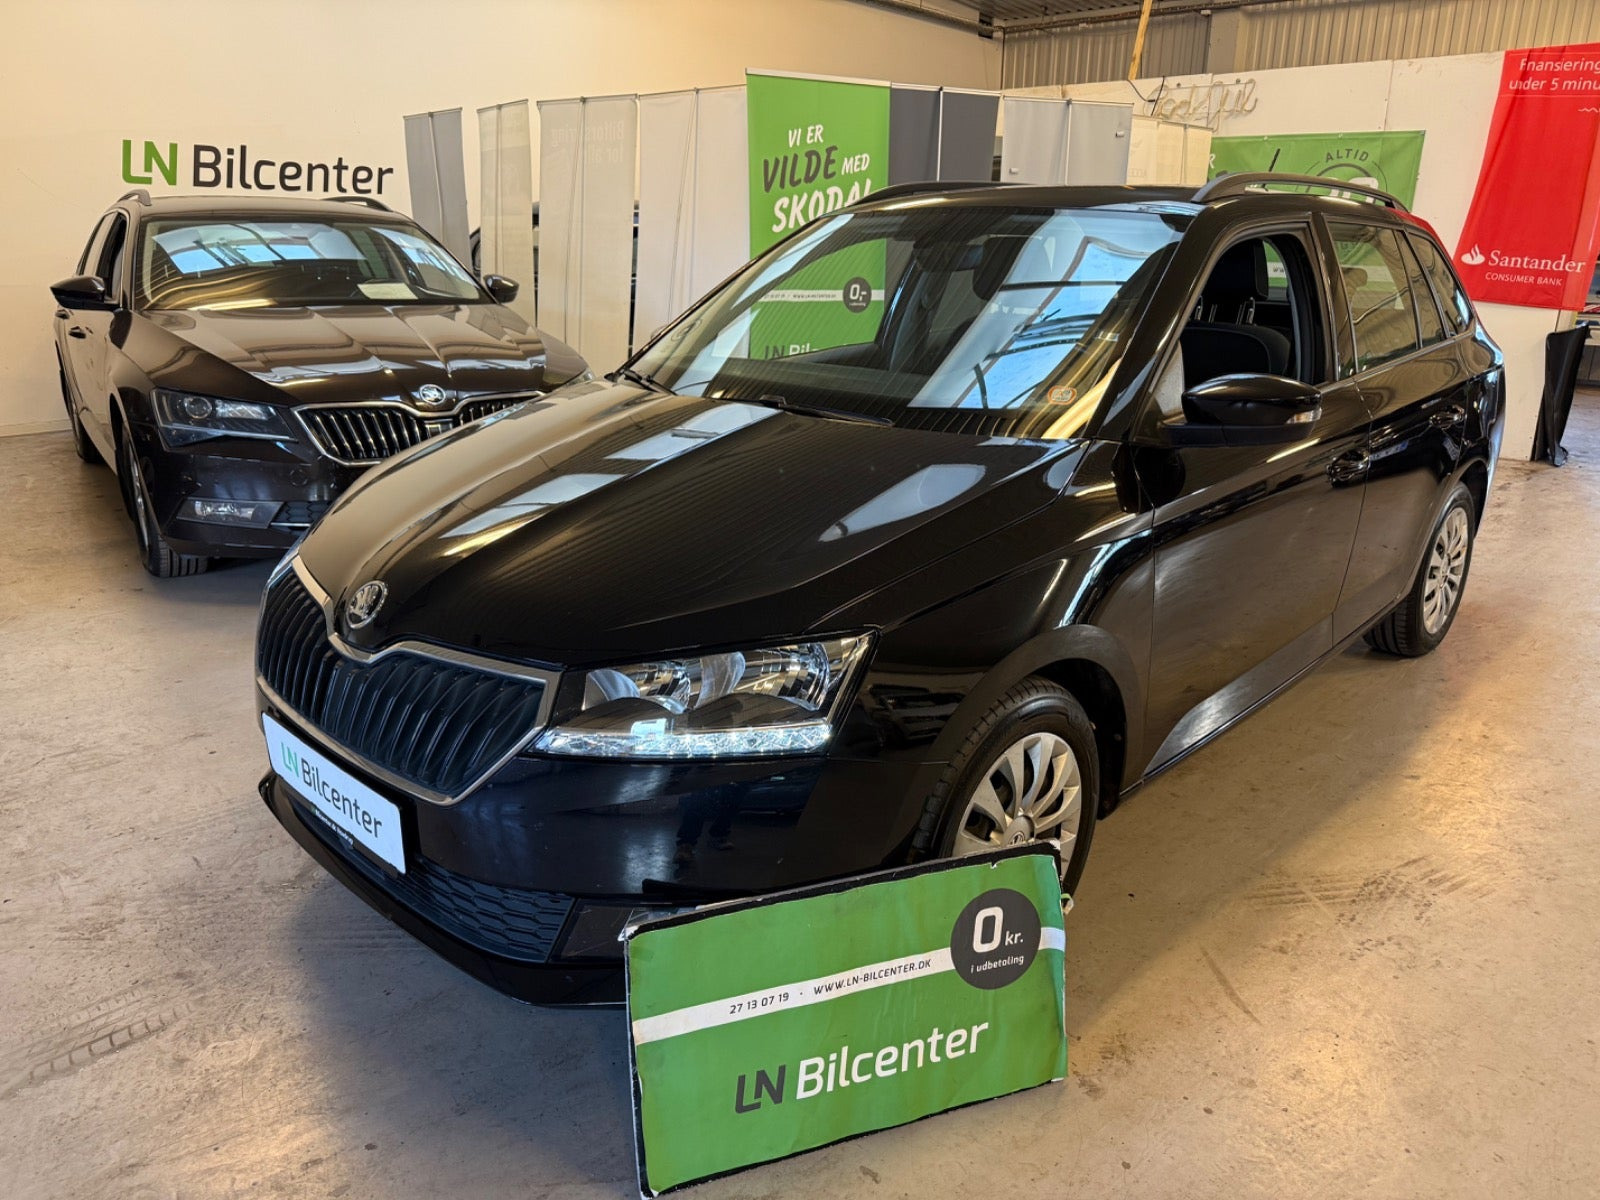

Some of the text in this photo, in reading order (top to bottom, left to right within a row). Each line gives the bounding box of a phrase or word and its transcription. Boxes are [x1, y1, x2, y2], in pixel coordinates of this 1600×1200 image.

[1549, 78, 1558, 91] 5
[788, 124, 824, 148] VI ER
[122, 139, 394, 195] LN Bilcenter
[763, 145, 870, 193] VILDE MED
[1325, 148, 1369, 163] ALTID
[1485, 272, 1562, 286] CONSUMER BANK
[1488, 250, 1586, 273] Santander
[281, 742, 299, 778] LN
[301, 757, 382, 838] Bilcenter
[972, 906, 1024, 953] 0 kr.
[976, 955, 1025, 973] udbetaling
[729, 958, 932, 1015] 27 13 07 19 WWW.LN-BILCENTER.DK
[734, 1022, 989, 1115] LN Bilcenter
